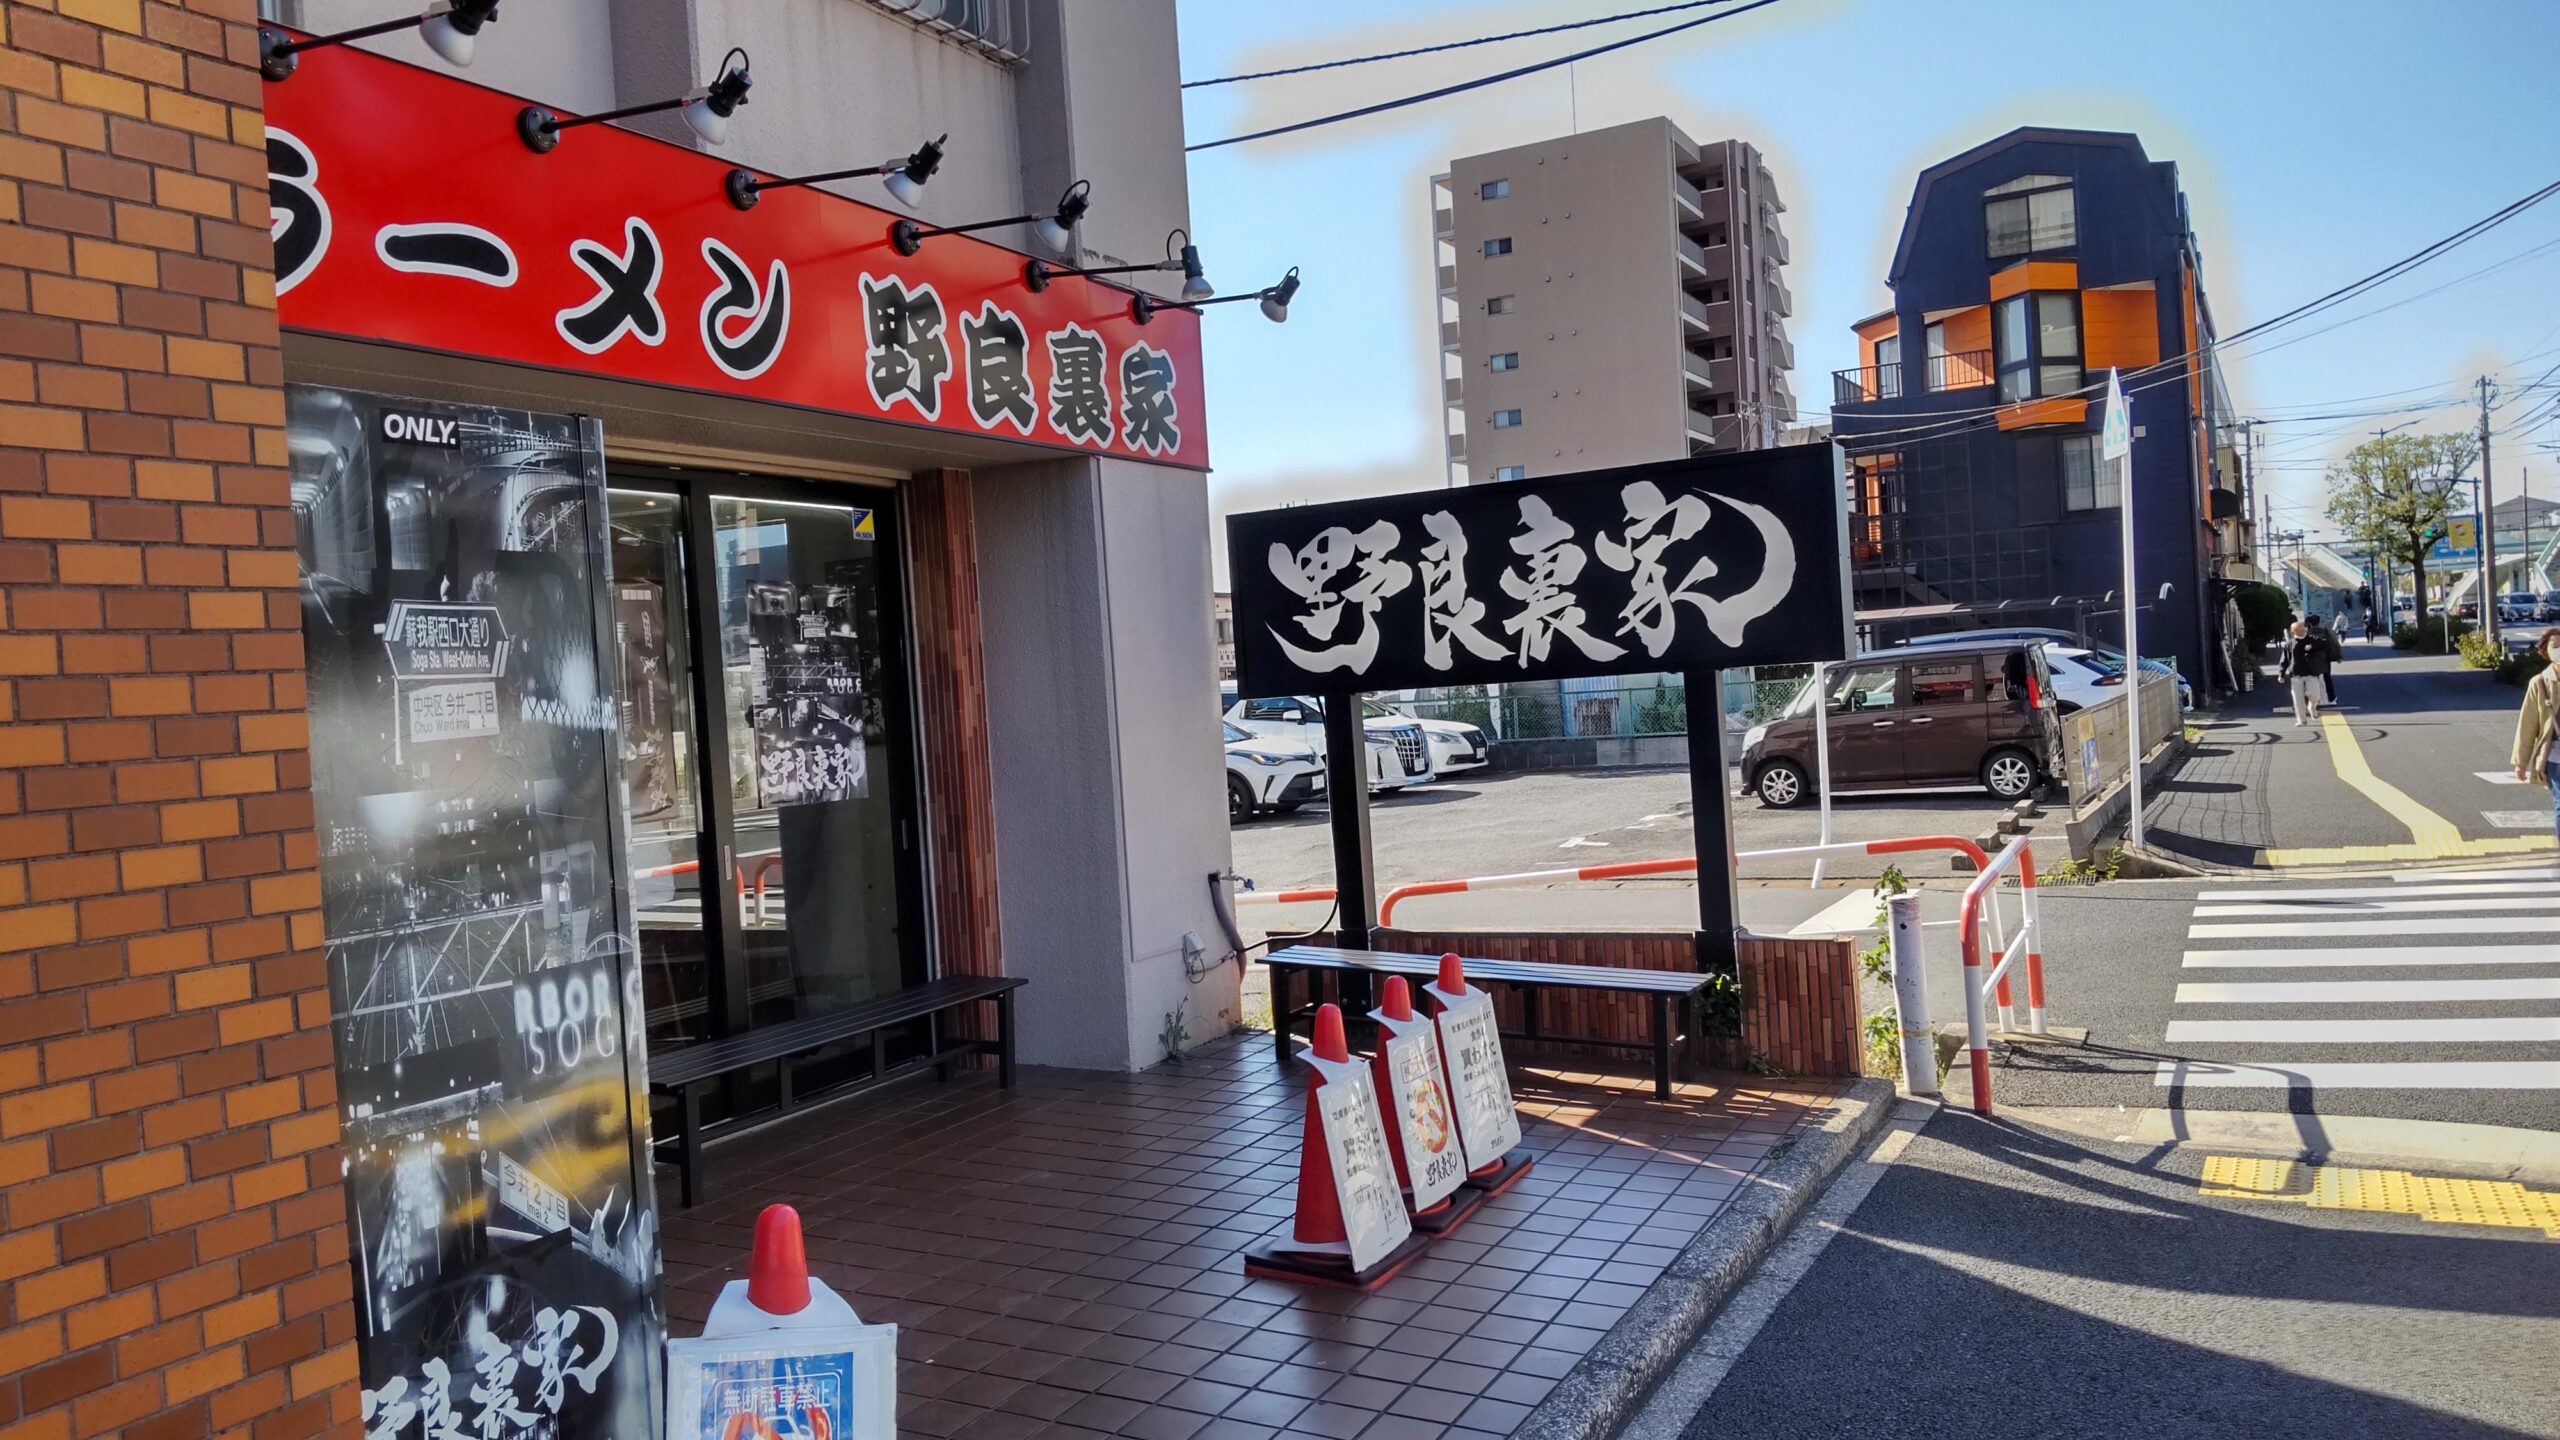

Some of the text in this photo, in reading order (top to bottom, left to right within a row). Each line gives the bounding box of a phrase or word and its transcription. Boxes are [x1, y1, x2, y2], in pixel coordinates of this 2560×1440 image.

[859, 272, 1181, 457] 野良裏家
[384, 413, 456, 445] ONLY.
[1265, 480, 1796, 676] 野良裏家
[405, 615, 489, 648] 蘇我駅西口大通り
[411, 650, 429, 673] Soga
[760, 743, 865, 795] 野良裏家
[503, 1164, 566, 1221] 今井2丁目
[723, 1380, 831, 1414] 無断駐車禁止
